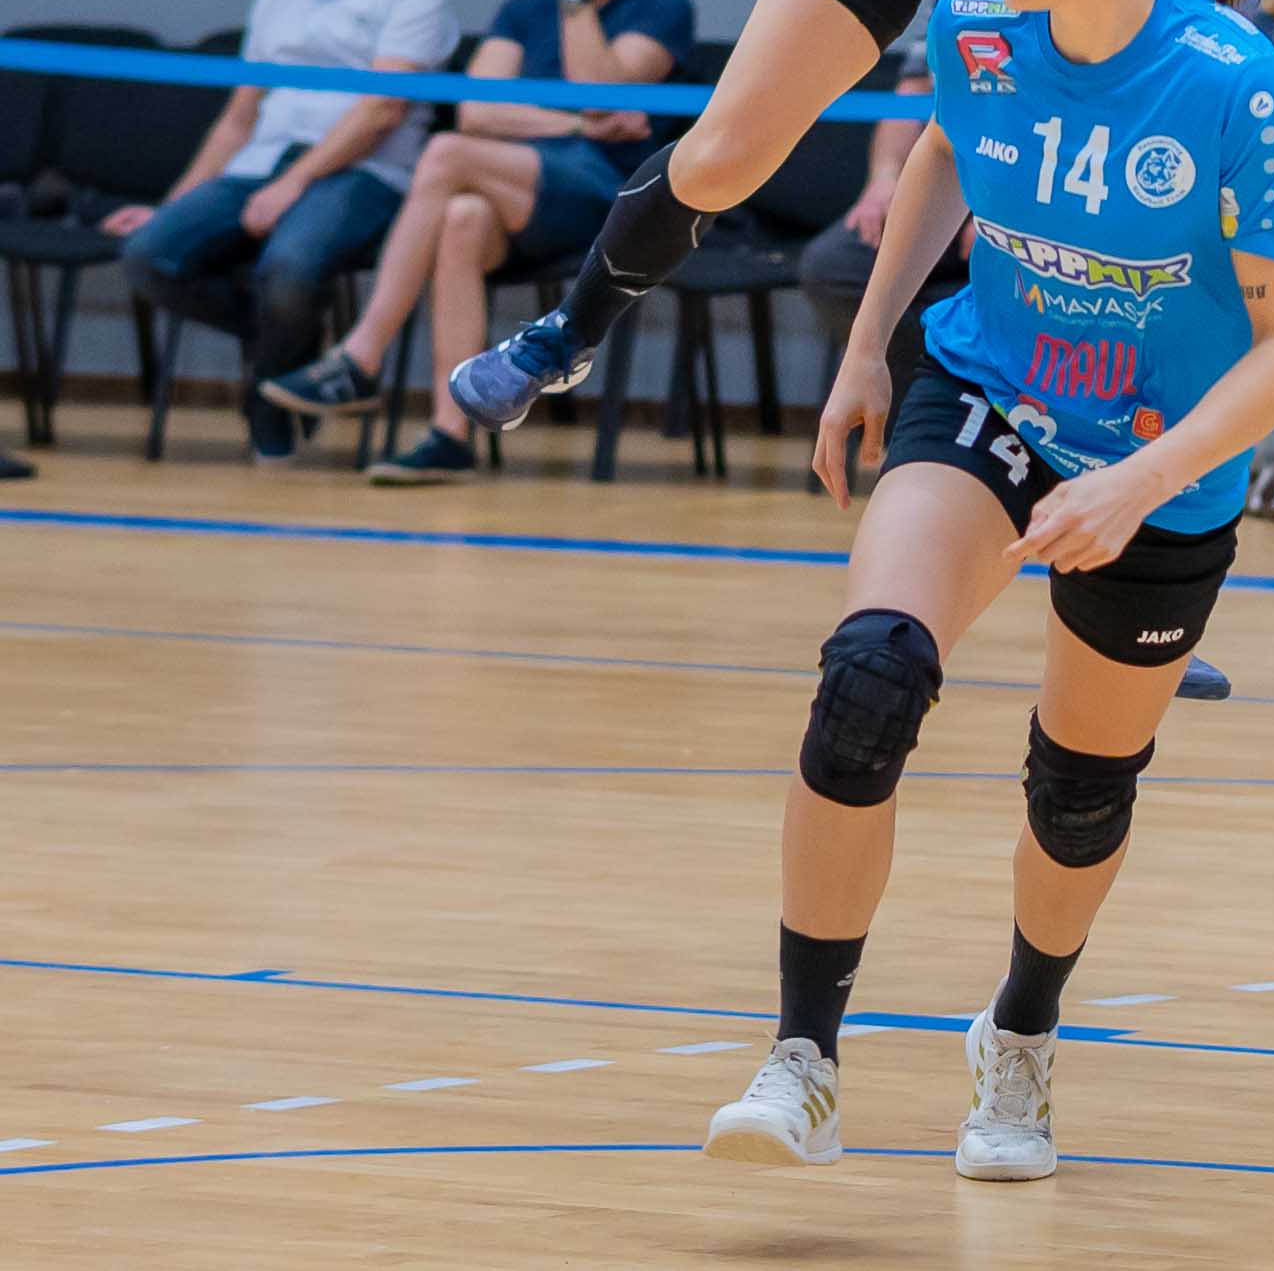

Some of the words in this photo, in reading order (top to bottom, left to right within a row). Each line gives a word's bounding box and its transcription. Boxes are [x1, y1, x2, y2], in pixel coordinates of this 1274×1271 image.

[975, 135, 1019, 165] JAKO
[1033, 116, 1110, 216] 14
[954, 392, 1031, 487] 14
[1136, 627, 1184, 644] JAKO
